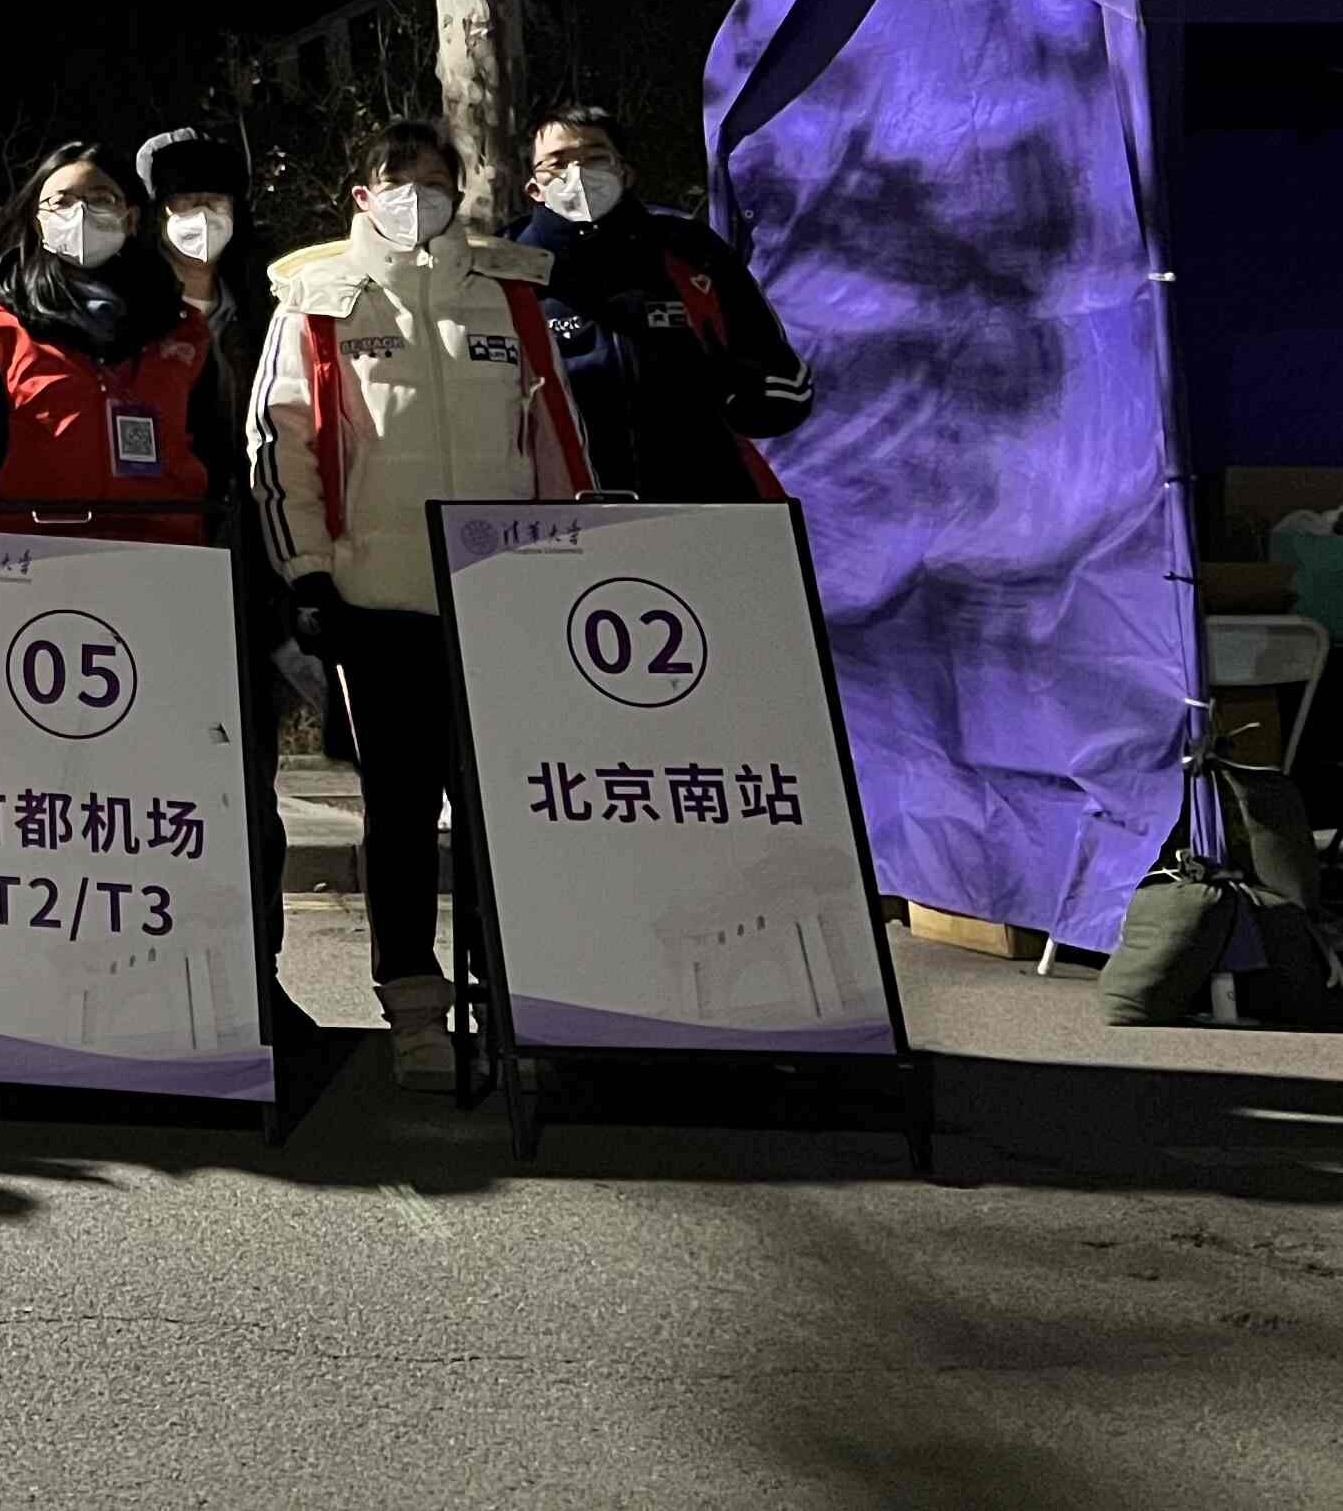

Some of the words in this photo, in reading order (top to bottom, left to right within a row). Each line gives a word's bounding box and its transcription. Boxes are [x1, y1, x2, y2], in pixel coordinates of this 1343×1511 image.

[22, 639, 122, 709] 05
[584, 609, 694, 675] 02
[527, 761, 804, 826] 北京南站
